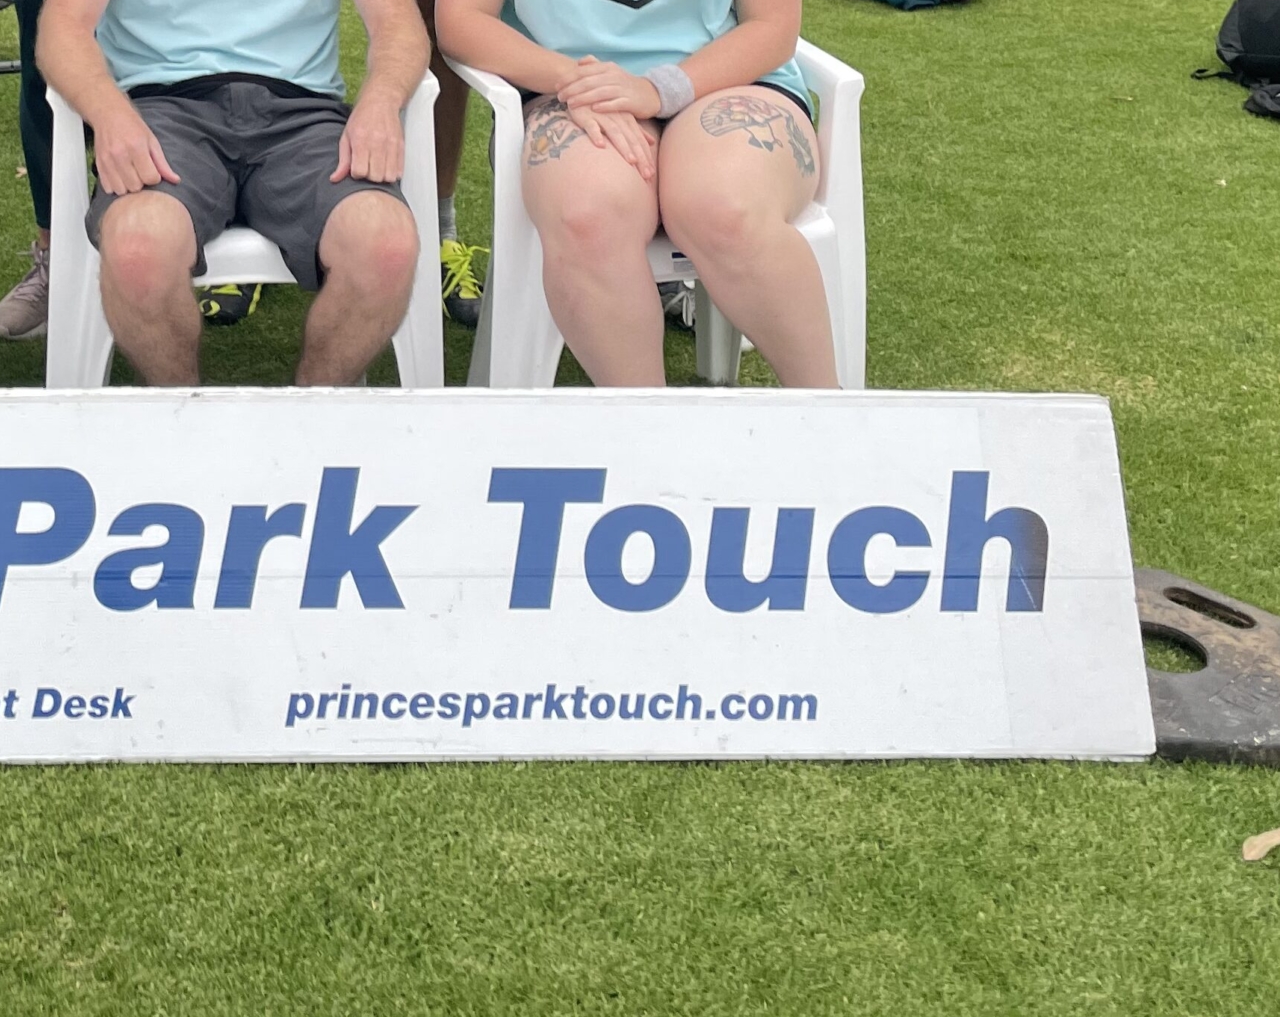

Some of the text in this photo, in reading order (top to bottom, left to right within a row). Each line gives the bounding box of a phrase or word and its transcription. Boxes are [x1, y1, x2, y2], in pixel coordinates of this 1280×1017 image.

[487, 467, 1046, 614] Touch
[31, 687, 132, 720] Desk
[284, 683, 817, 728] princesparktouch.com
